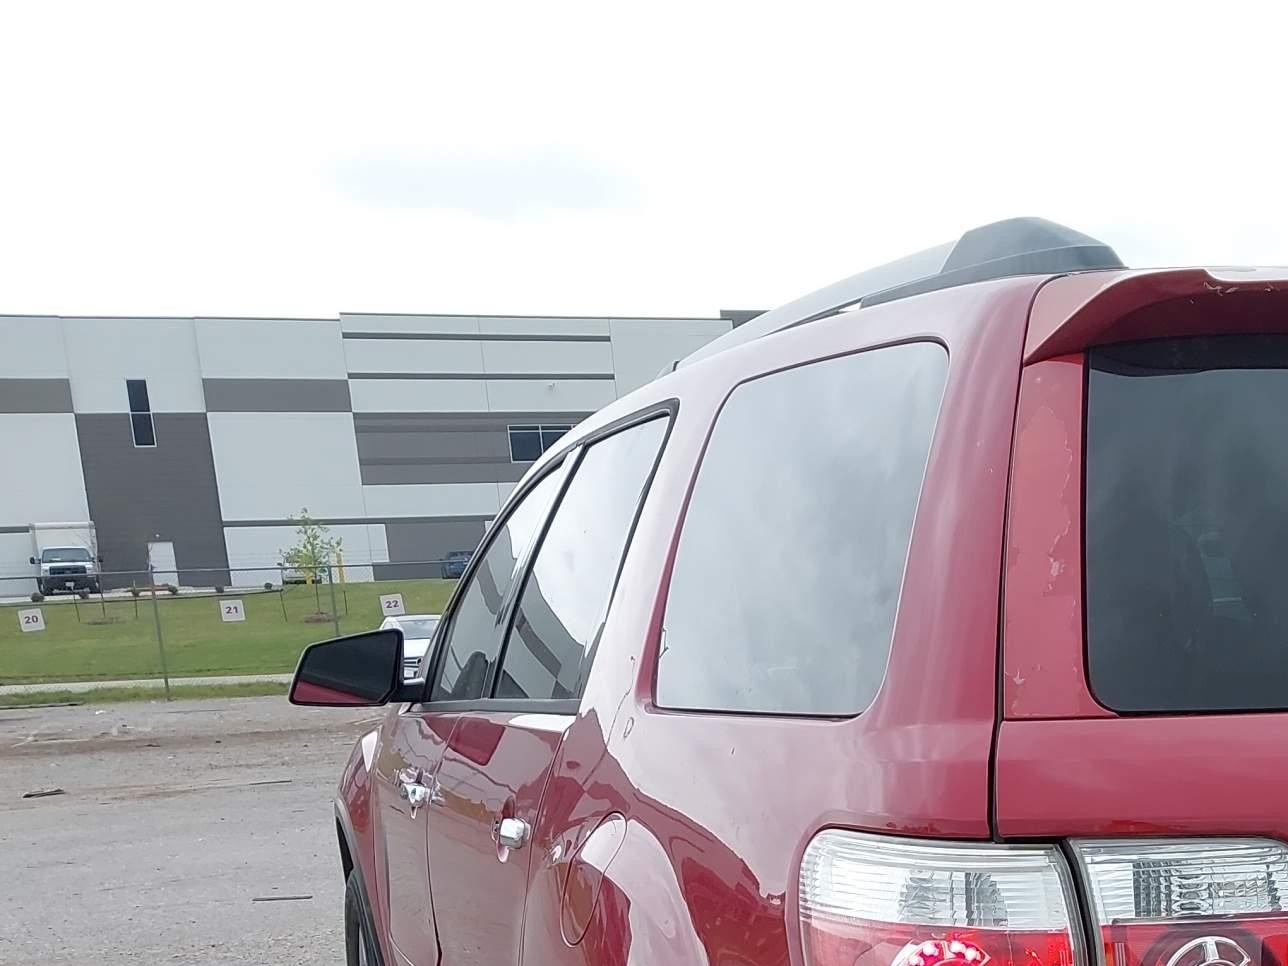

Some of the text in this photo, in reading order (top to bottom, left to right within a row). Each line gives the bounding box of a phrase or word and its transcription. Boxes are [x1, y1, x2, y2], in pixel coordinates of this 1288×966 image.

[385, 600, 400, 609] 22
[225, 606, 239, 615] 21
[24, 615, 39, 625] 20
